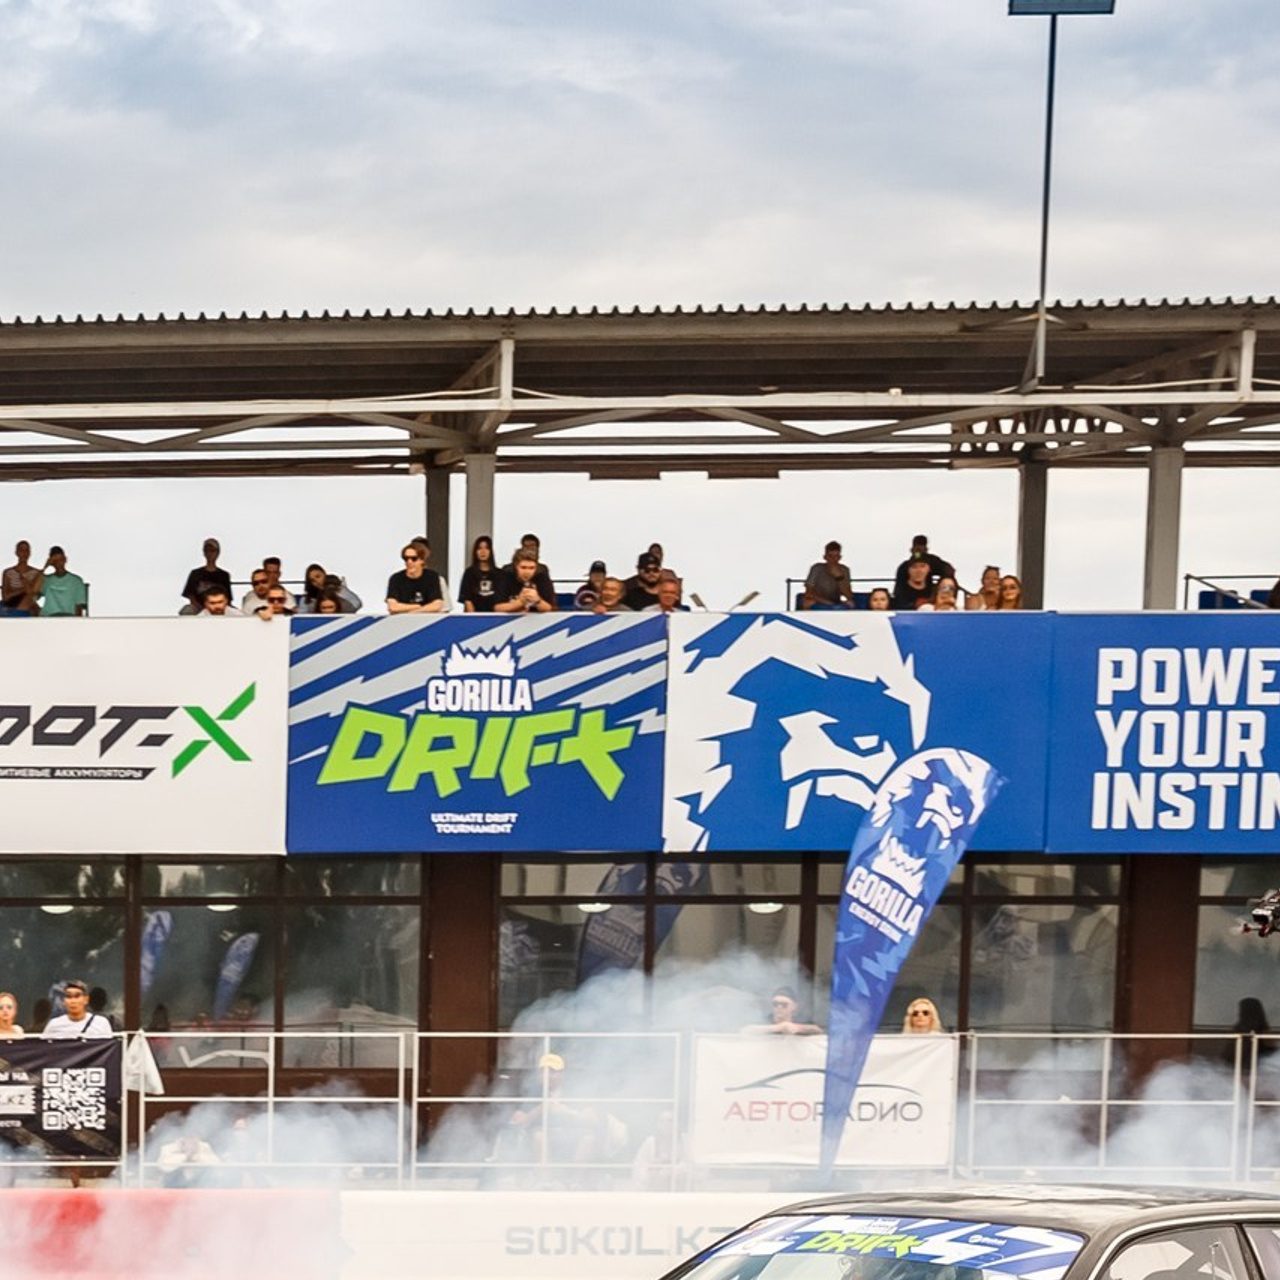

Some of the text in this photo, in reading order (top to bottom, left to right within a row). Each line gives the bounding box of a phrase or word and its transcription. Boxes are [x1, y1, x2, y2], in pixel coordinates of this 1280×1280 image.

[427, 678, 534, 713] GORILLA
[1094, 709, 1267, 768] YOUR
[430, 812, 518, 823] ULTIMATE DRIFT
[435, 823, 513, 834] TOURNAMENT
[845, 865, 924, 937] GORILLA
[12, 1071, 29, 1082] НА
